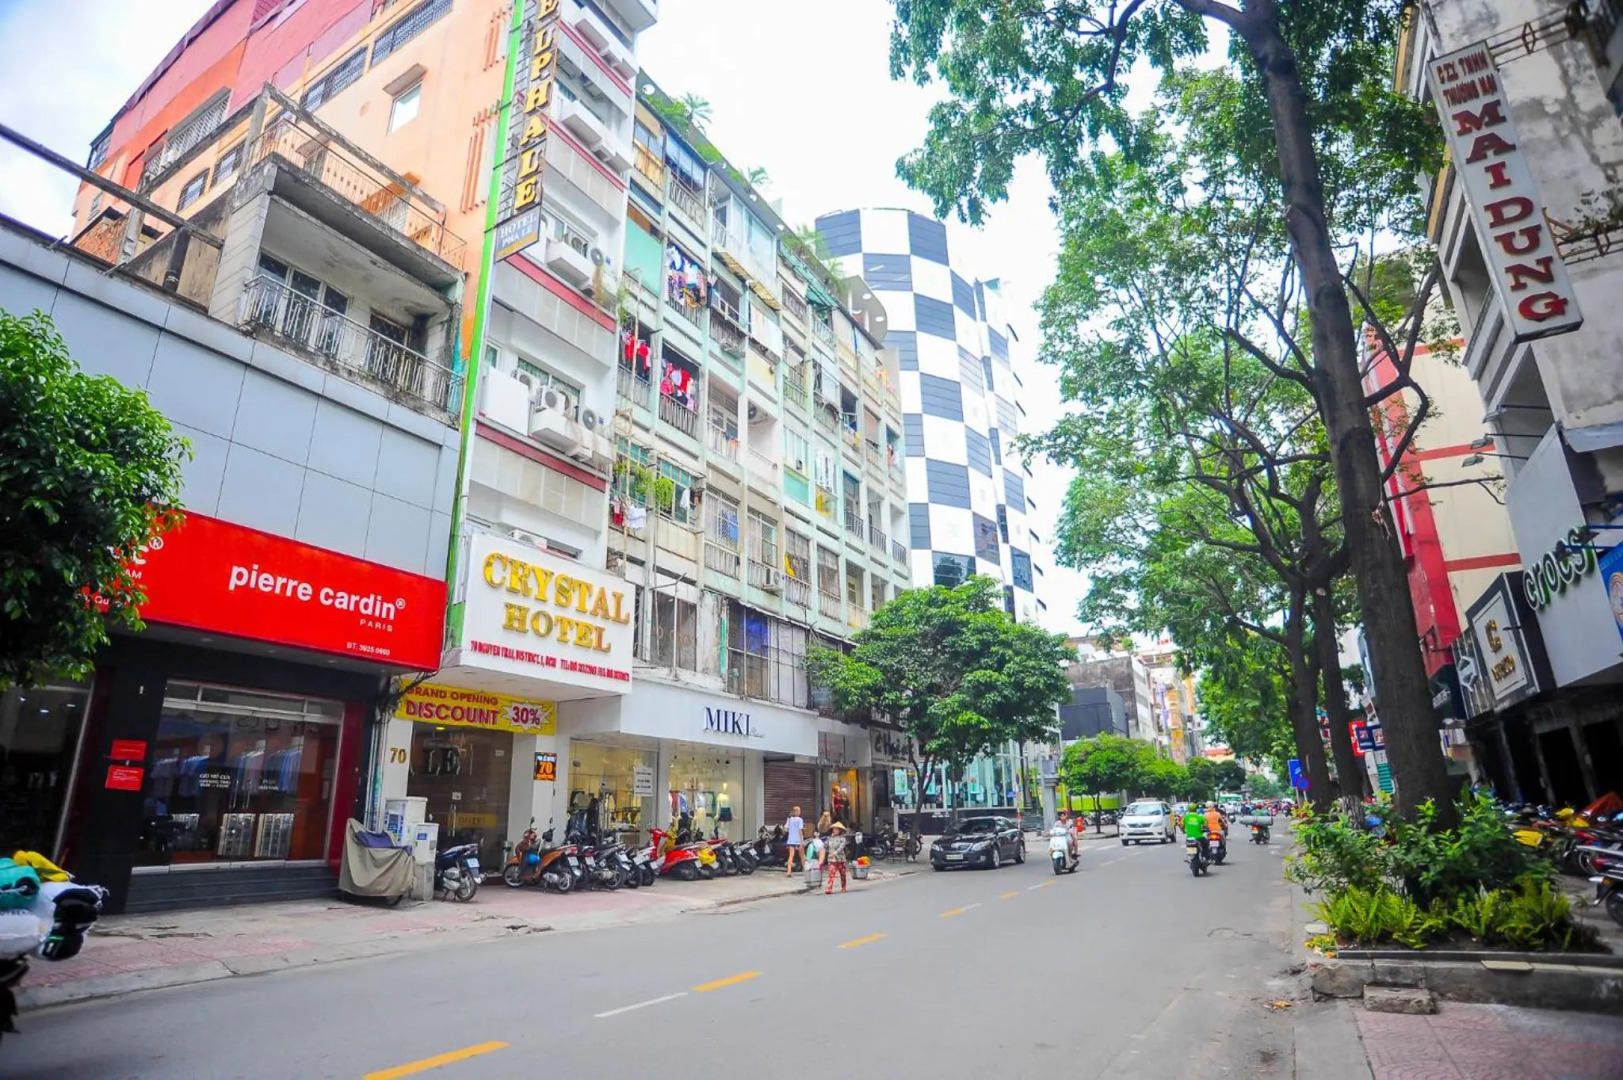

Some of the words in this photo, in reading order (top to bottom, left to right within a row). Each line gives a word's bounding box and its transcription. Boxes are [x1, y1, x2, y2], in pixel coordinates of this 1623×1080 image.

[1522, 525, 1593, 611] crocs
[228, 563, 313, 602] pierre
[483, 552, 630, 625] CRYSTAL
[360, 618, 393, 632] PARIS
[503, 602, 611, 653] HOTEL
[406, 686, 447, 699] GRAND
[450, 691, 499, 706] OPENING
[405, 700, 500, 725] DISCOUNT
[512, 705, 541, 726] 30%
[704, 706, 750, 736] MIKI
[390, 747, 407, 764] 70
[539, 761, 553, 776] 70
